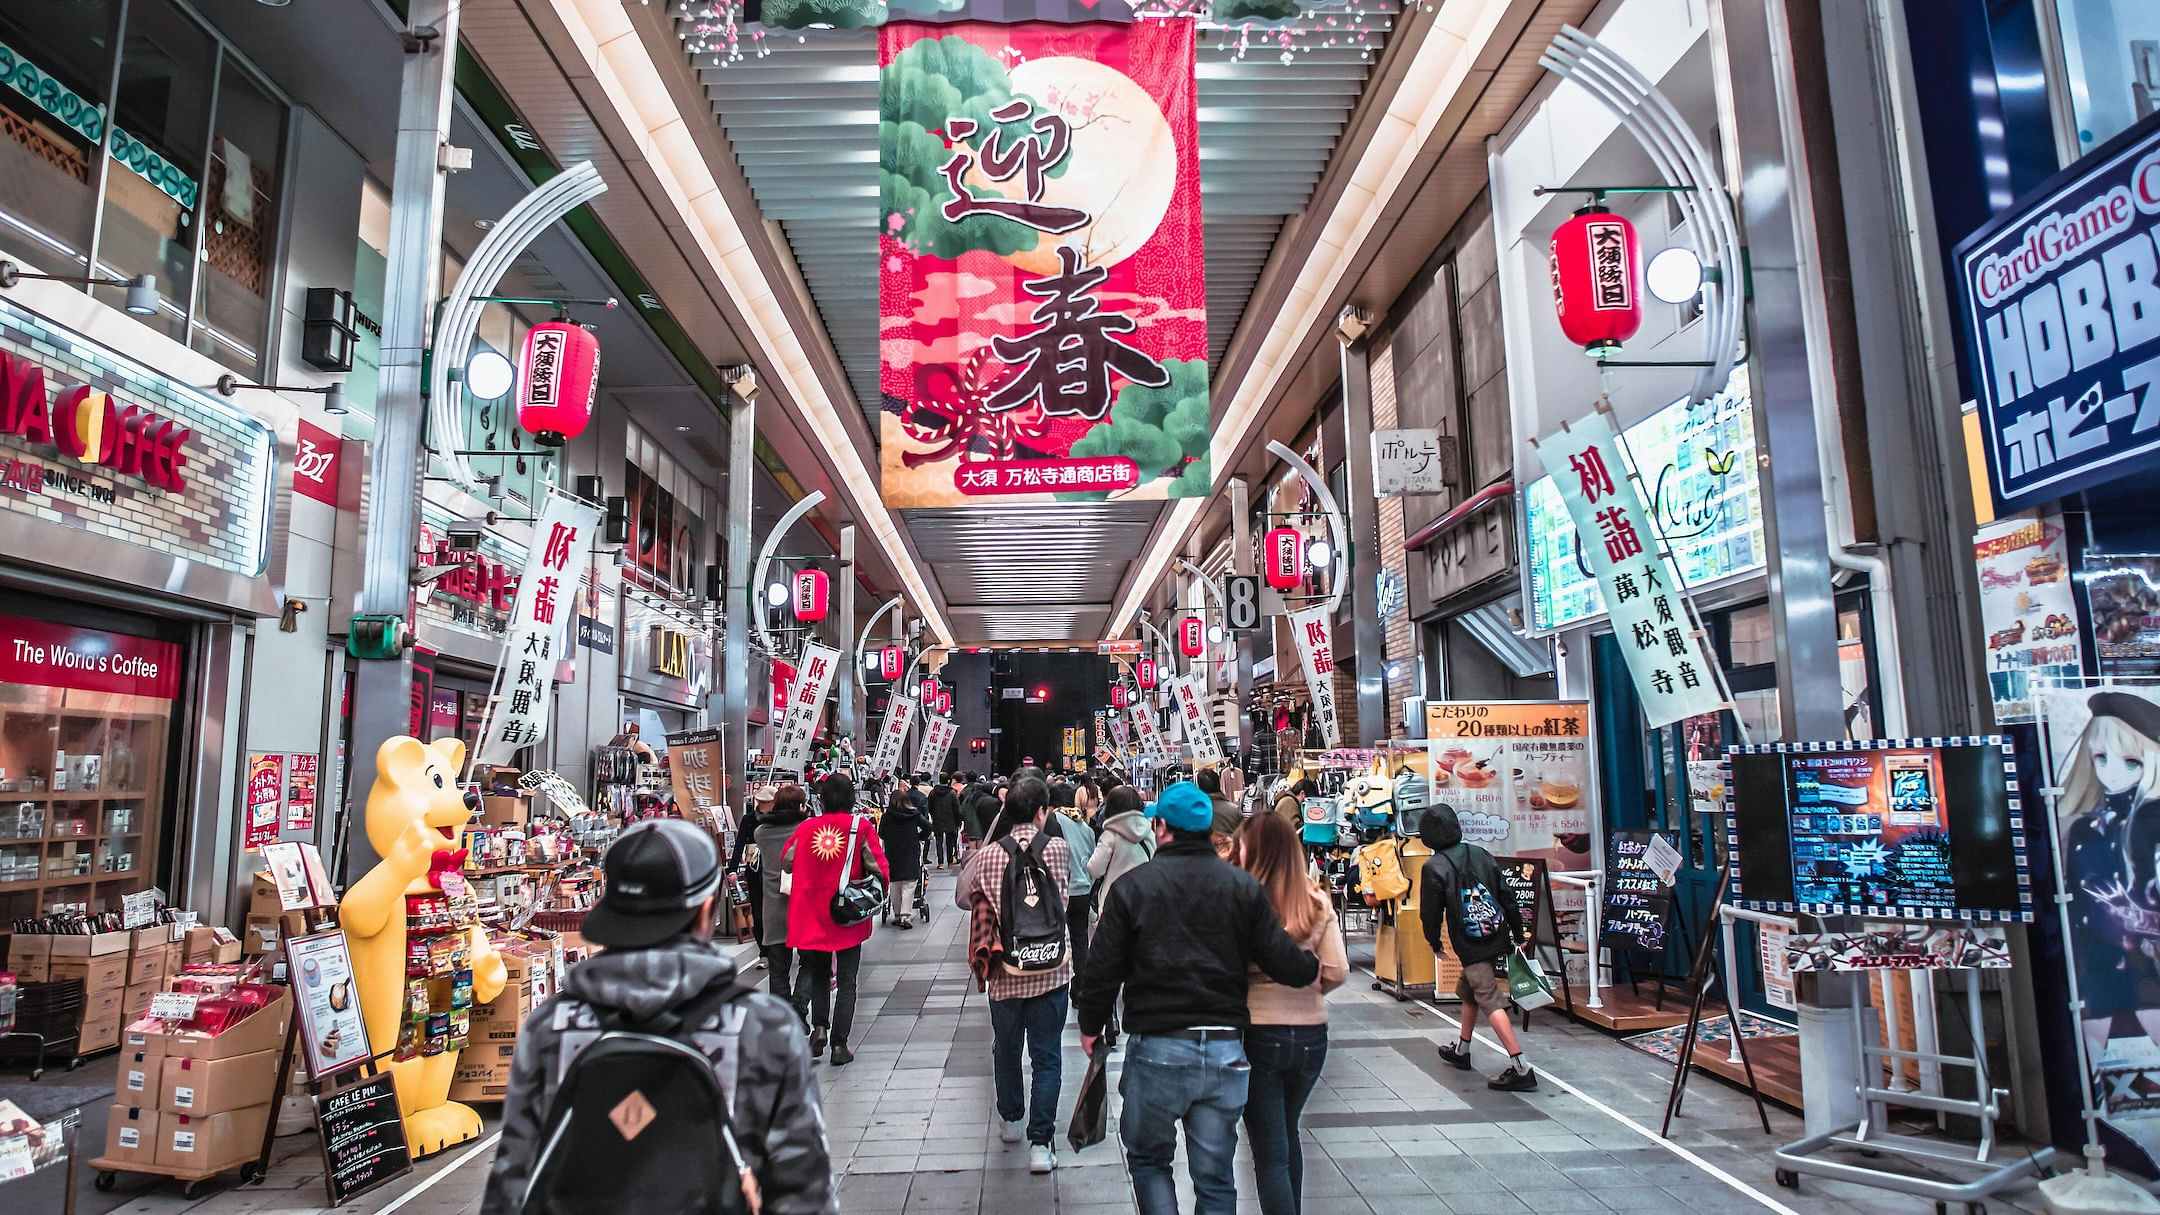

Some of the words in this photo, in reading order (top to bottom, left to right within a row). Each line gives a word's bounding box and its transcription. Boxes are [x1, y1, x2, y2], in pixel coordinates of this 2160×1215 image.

[940, 101, 1170, 420] 迎春
[1980, 194, 2128, 300] CardGame
[1985, 224, 2160, 408] HOBB
[51, 384, 191, 494] COFFEE
[1382, 440, 1437, 474] ポルテ
[44, 469, 86, 498] SINCE
[961, 469, 998, 488] 大須
[1005, 464, 1131, 486] 万松寺通商店街
[1568, 444, 1643, 564] 初詣
[1230, 577, 1257, 628] 8
[1612, 572, 1674, 695] 萬松寺
[1641, 564, 1701, 690] 大須観音
[13, 639, 45, 665] The
[50, 643, 107, 673] World's
[111, 653, 158, 679] Coffee
[1431, 706, 1489, 719] こだわりの
[1456, 718, 1580, 737] 20種類以上の紅茶
[1617, 840, 1648, 855] 紅茶カフ
[1616, 878, 1658, 891] オススメ紅茶
[352, 1089, 361, 1101] LE
[362, 1085, 377, 1099] PIN
